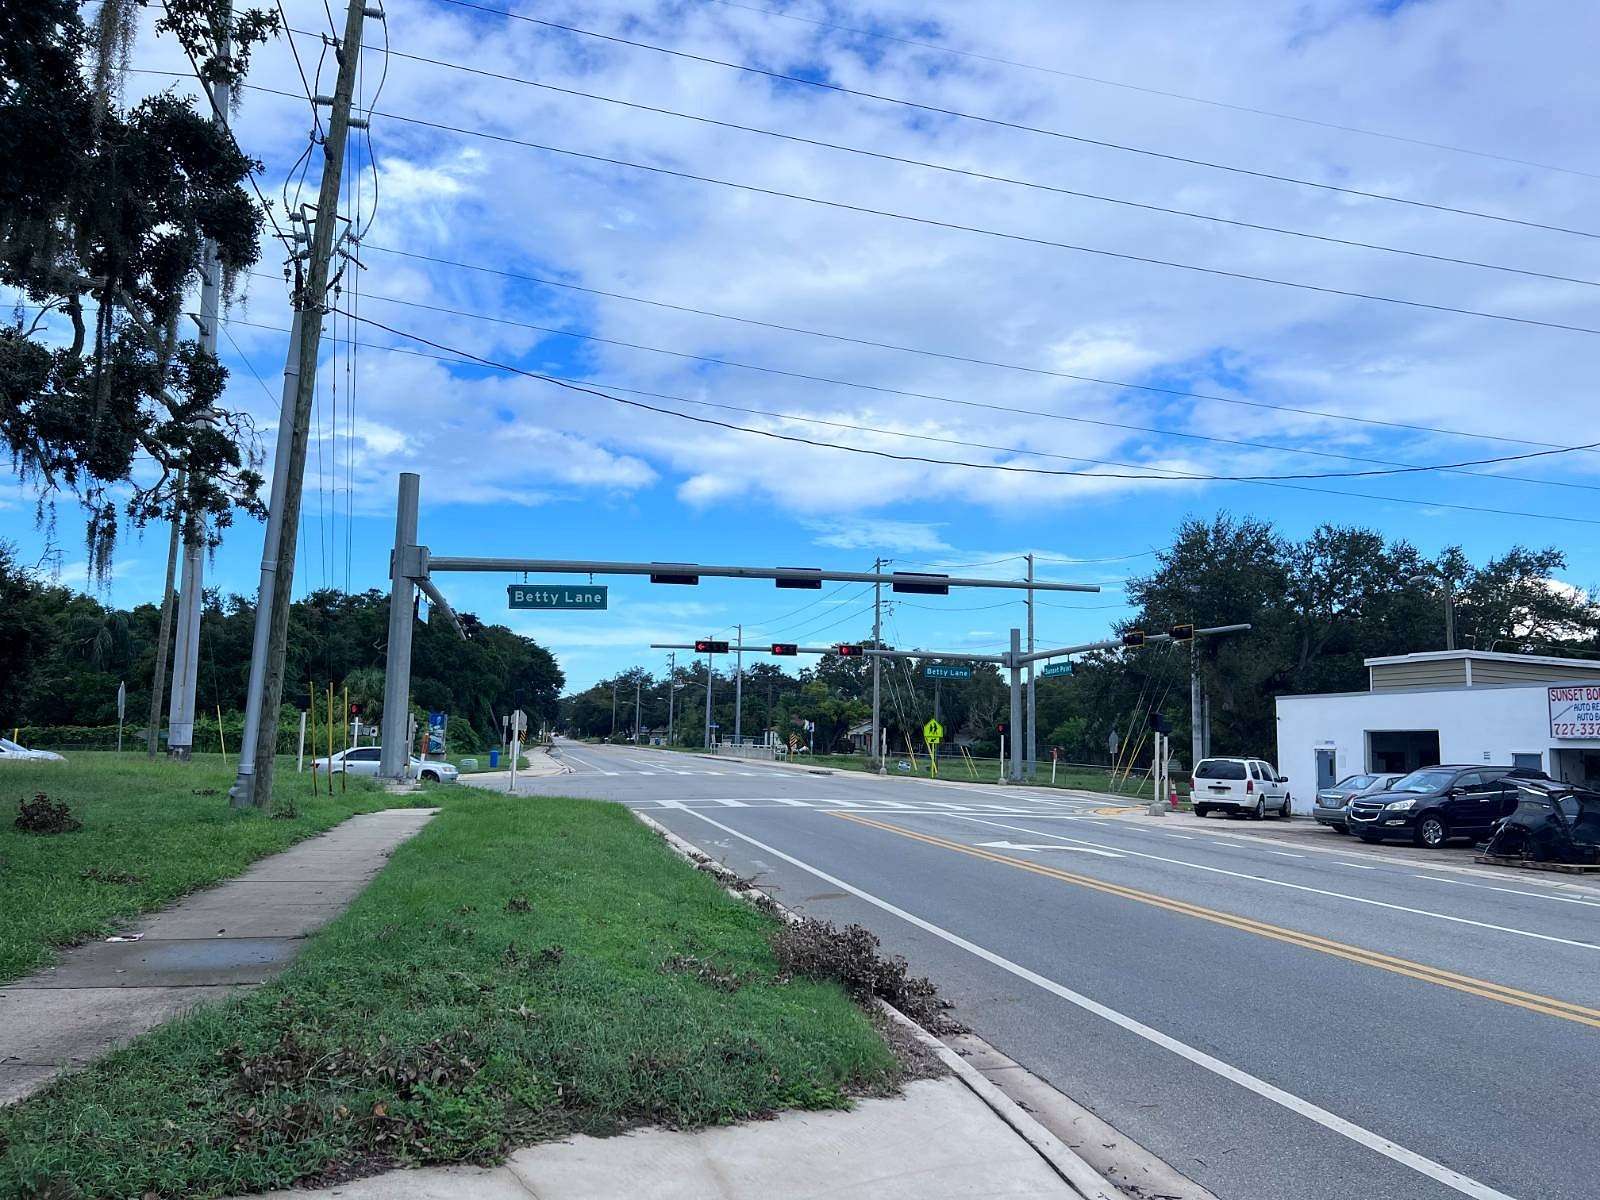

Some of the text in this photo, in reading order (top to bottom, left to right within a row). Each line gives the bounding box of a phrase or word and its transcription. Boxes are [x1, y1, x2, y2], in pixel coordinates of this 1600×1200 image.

[515, 591, 602, 605] Betty Lane
[927, 668, 948, 676] Betty
[1551, 689, 1583, 701] SUNSET
[1574, 703, 1590, 711] AUTO
[1577, 713, 1593, 721] AUTO
